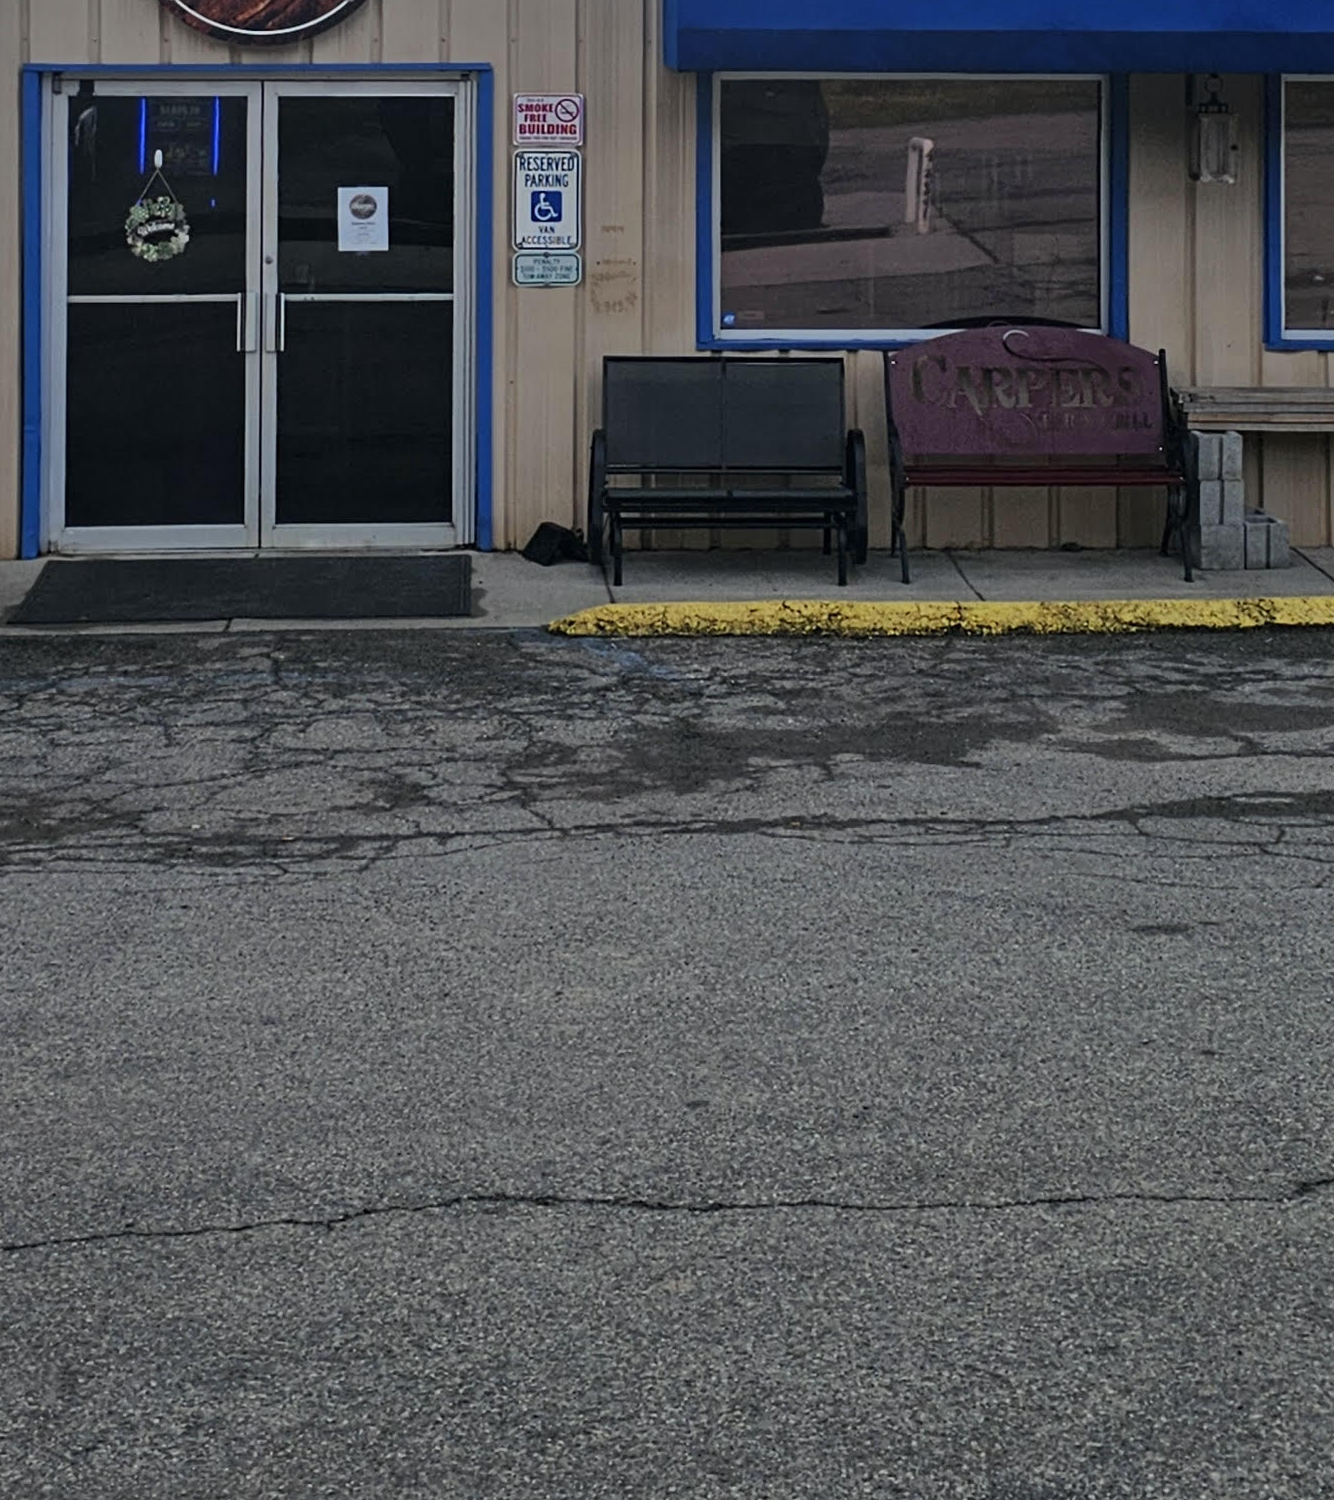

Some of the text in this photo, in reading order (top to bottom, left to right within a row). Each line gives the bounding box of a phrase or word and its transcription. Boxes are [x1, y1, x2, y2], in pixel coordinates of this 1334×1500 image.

[518, 103, 554, 113] SMOKE
[524, 113, 547, 123] FREE
[518, 123, 578, 135] BUILDING
[519, 156, 575, 172] RESERVED
[524, 173, 569, 188] PARKING
[538, 225, 555, 233] VAN
[521, 235, 572, 245] ACCESSIBLE
[911, 346, 1141, 416] CARPERS
